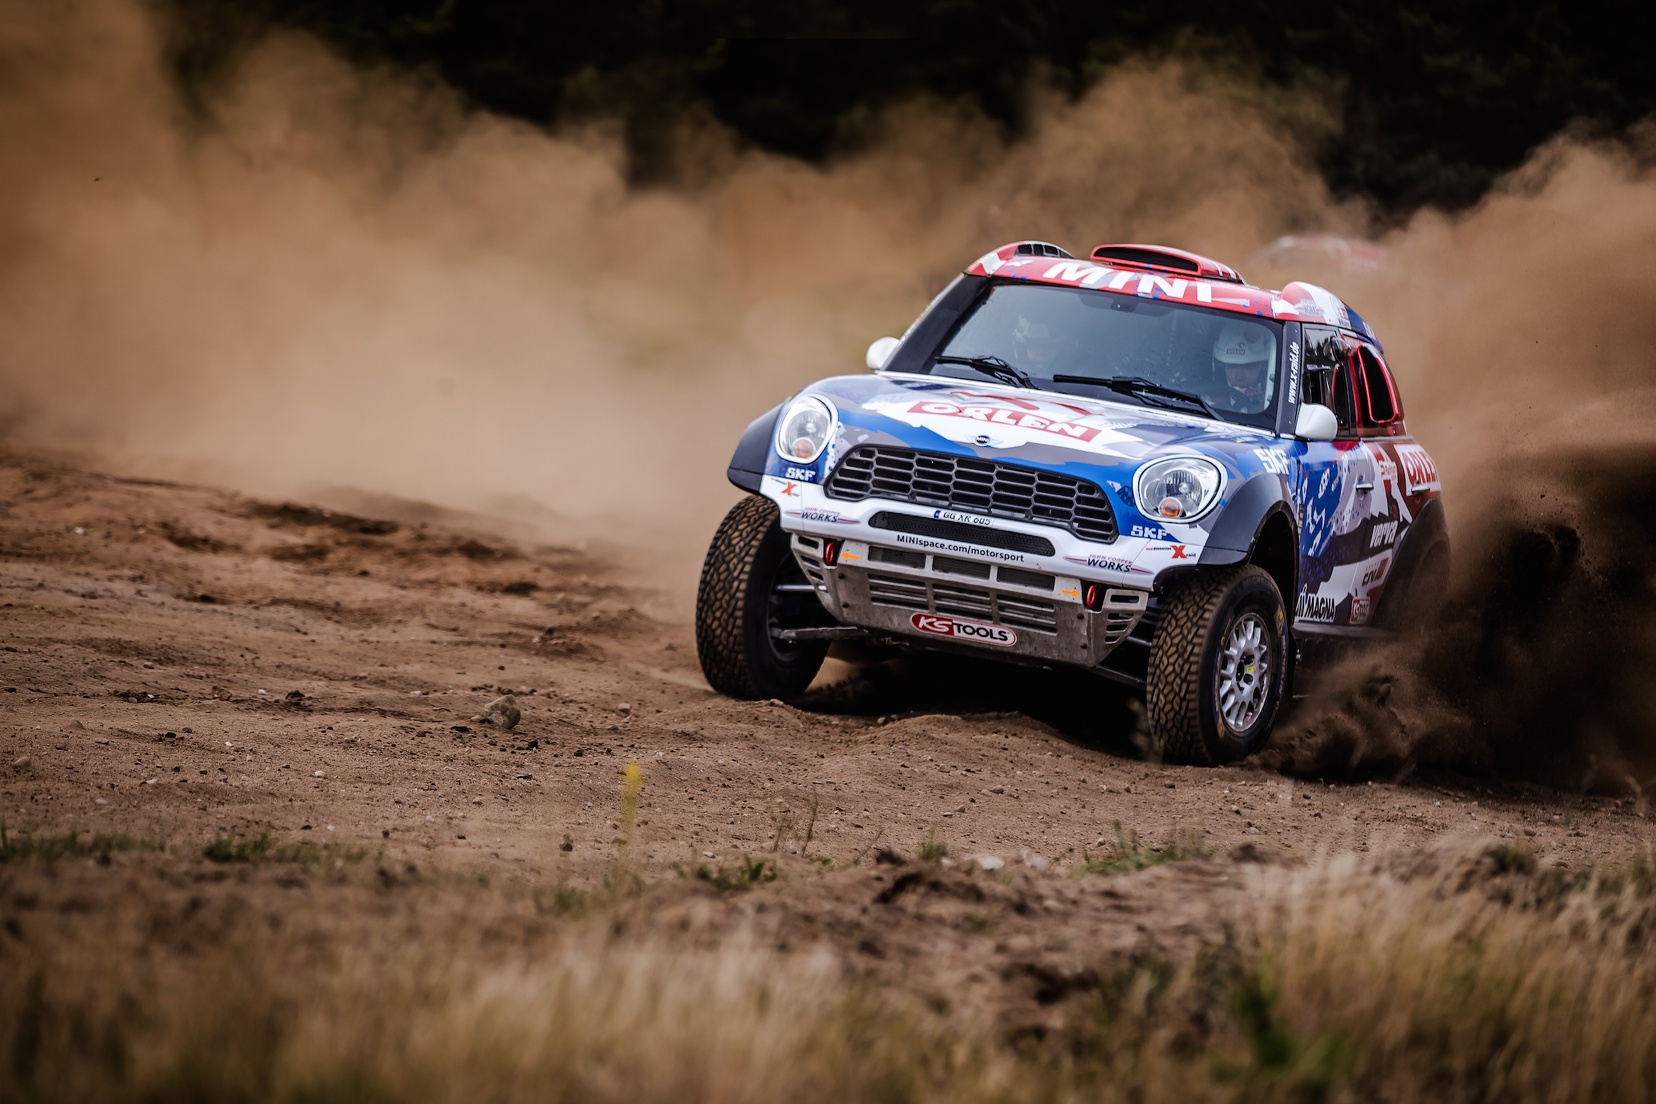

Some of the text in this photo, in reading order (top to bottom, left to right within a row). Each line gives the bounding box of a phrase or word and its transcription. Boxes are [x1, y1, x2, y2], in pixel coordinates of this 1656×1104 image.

[1043, 261, 1212, 303] MINI
[1287, 341, 1300, 405] www.x-raid.de
[920, 403, 1090, 438] ORLEN
[785, 467, 816, 481] SKF
[1252, 448, 1289, 475] SKF
[801, 511, 839, 523] WORKS
[1131, 525, 1167, 539] SKF
[1369, 519, 1399, 549] verva
[896, 534, 1025, 563] MINIspace.com/motorsport
[1107, 556, 1133, 565] COOPER
[1086, 558, 1131, 573] WORKS
[1304, 595, 1336, 621] MAGNA
[951, 622, 1009, 642] TOOLS
